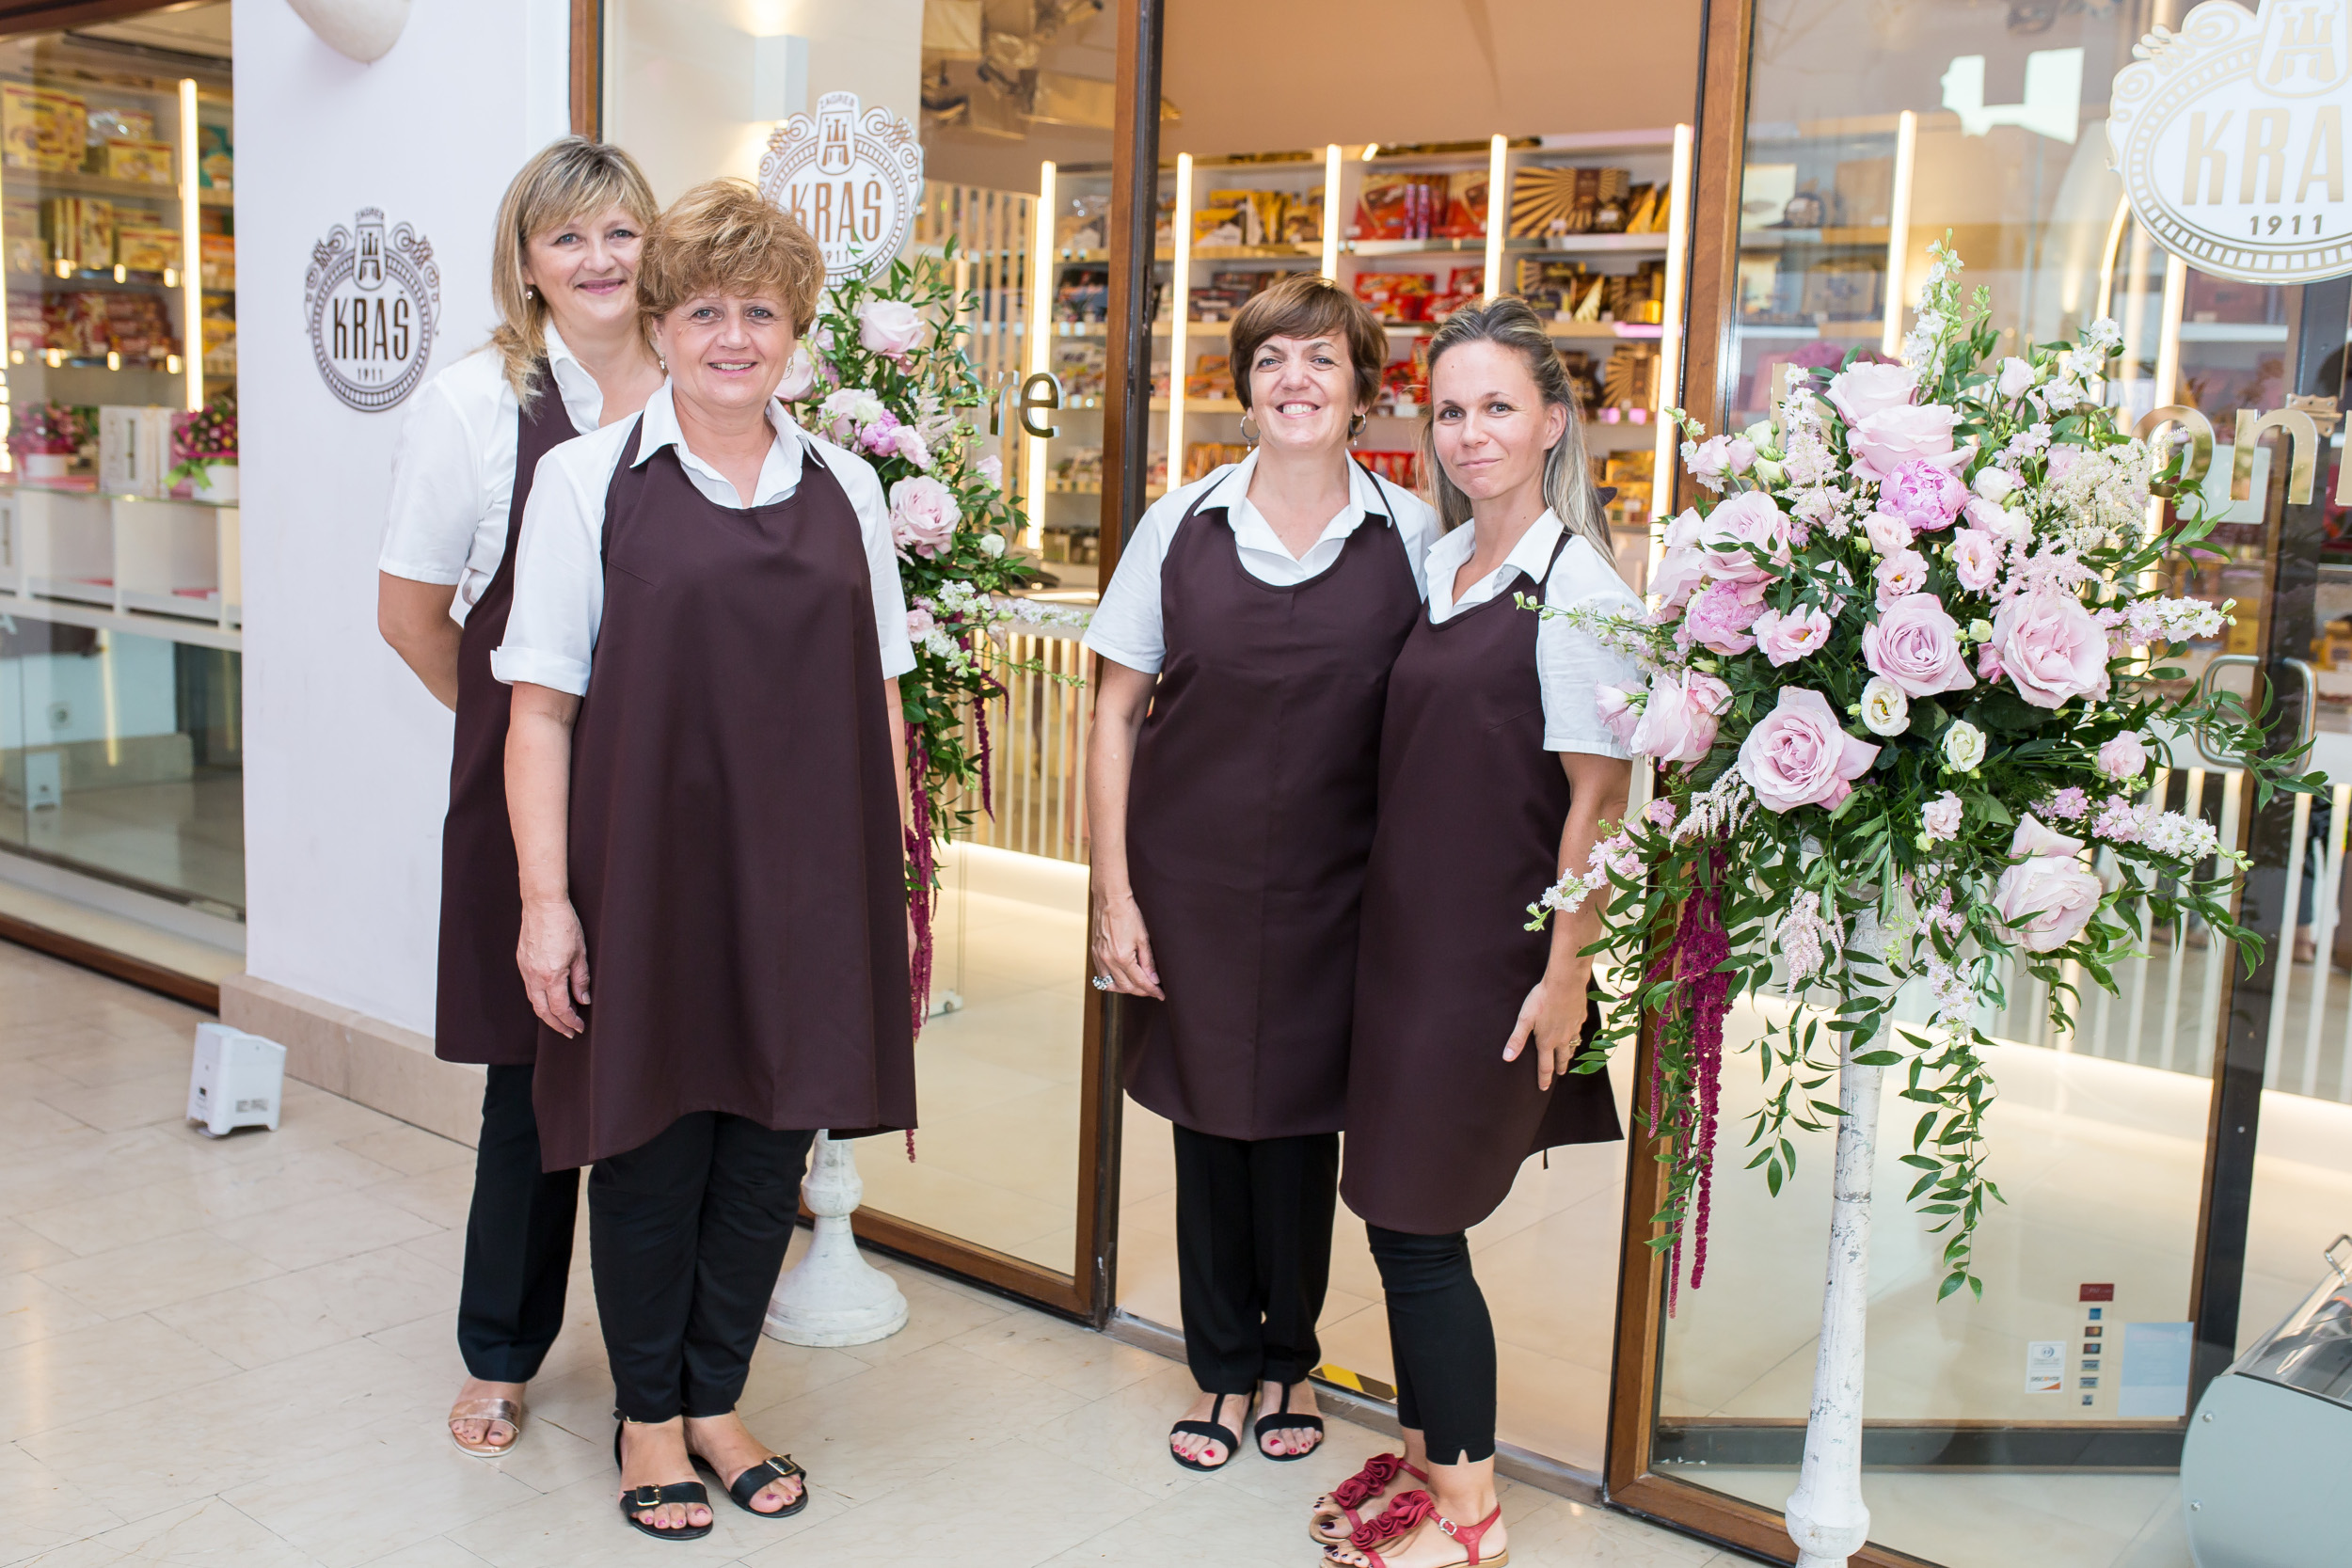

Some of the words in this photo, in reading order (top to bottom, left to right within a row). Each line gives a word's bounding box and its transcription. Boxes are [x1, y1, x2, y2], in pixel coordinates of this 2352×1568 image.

[2182, 105, 2344, 205] KRA
[791, 172, 881, 243] KRAŠ
[2249, 214, 2323, 235] 1911
[333, 290, 409, 361] KRAŠ
[358, 368, 384, 382] 1911
